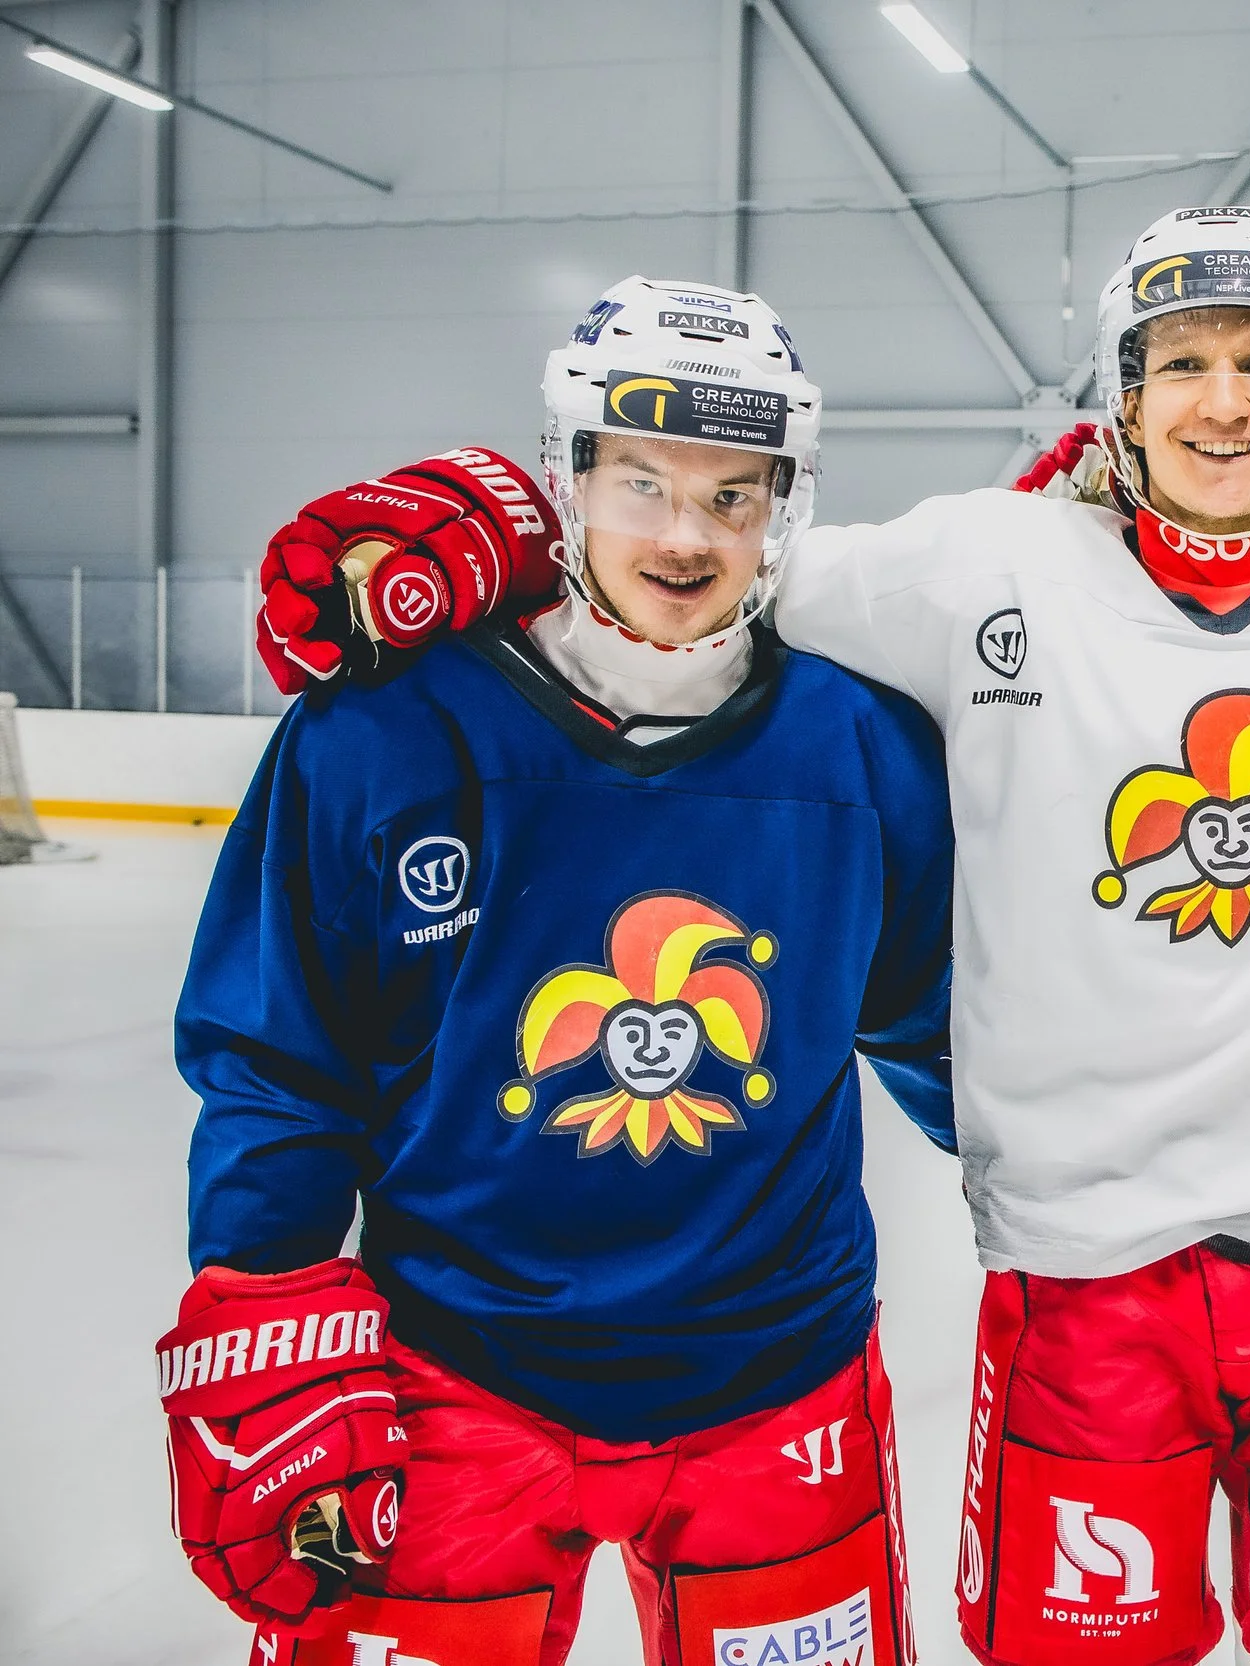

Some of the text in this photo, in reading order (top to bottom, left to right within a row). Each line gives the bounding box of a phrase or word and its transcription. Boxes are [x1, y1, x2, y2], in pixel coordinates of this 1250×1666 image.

[1180, 208, 1250, 220] PAIKKA
[1216, 284, 1233, 292] NEP
[1234, 284, 1250, 293] Live
[664, 313, 744, 336] PAIKKA
[664, 358, 742, 379] WARRIOR
[692, 387, 779, 410] CREATIVE
[691, 401, 779, 421] TECHNOLOGY
[701, 424, 767, 440] NEP Live Events
[346, 492, 419, 511] ALPHA
[971, 688, 1043, 707] WARRIOR
[403, 907, 482, 944] WARRIO
[252, 1445, 328, 1505] ALPHA
[1042, 1607, 1159, 1626] NORMIPUTKI
[720, 1599, 868, 1666] CABLE
[1080, 1629, 1121, 1637] EST. 1989
